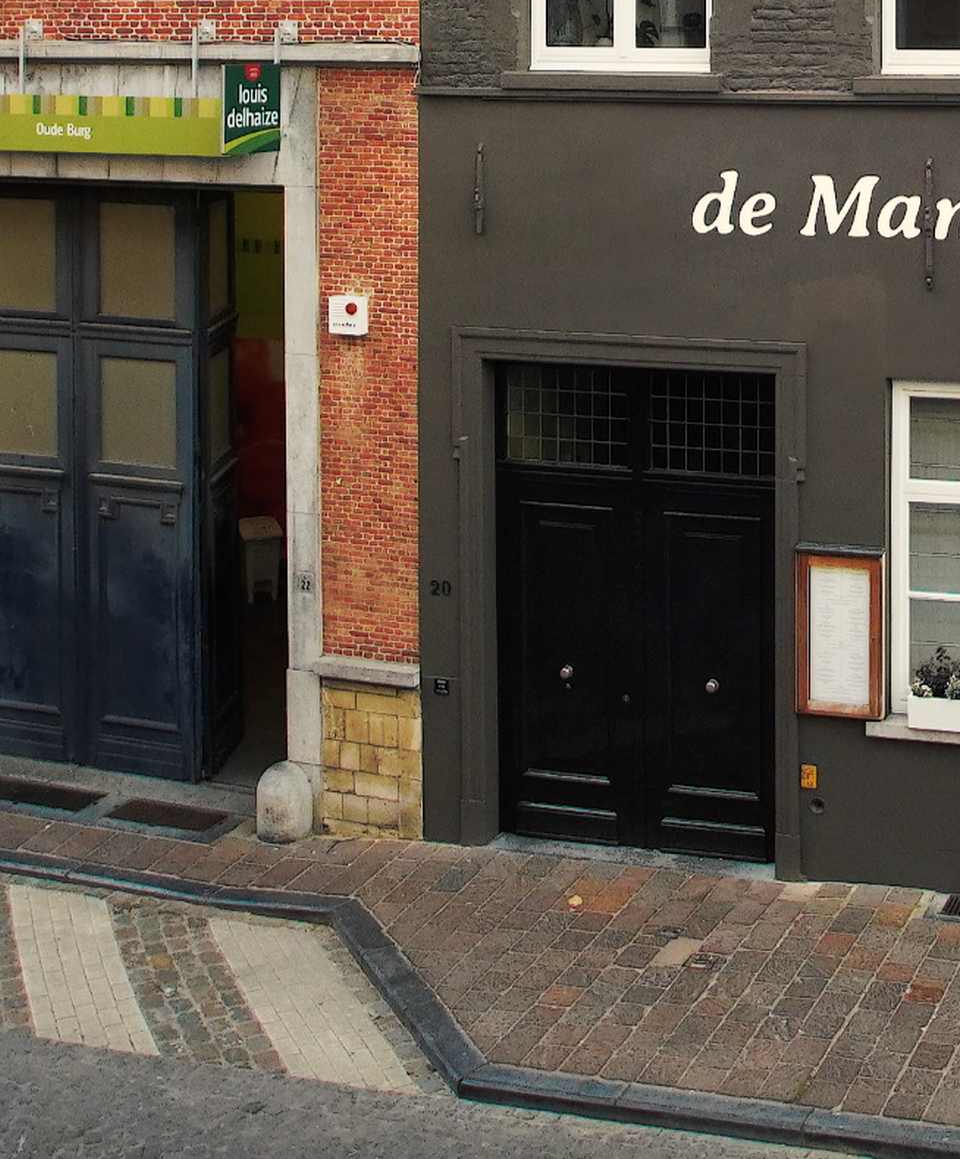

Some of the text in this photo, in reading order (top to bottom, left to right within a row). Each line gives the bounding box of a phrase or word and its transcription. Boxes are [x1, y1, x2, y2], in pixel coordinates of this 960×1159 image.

[239, 83, 268, 104] louis
[227, 106, 279, 129] delhaize
[36, 122, 92, 139] Oude Burg
[691, 169, 778, 237] de
[430, 580, 452, 597] 20
